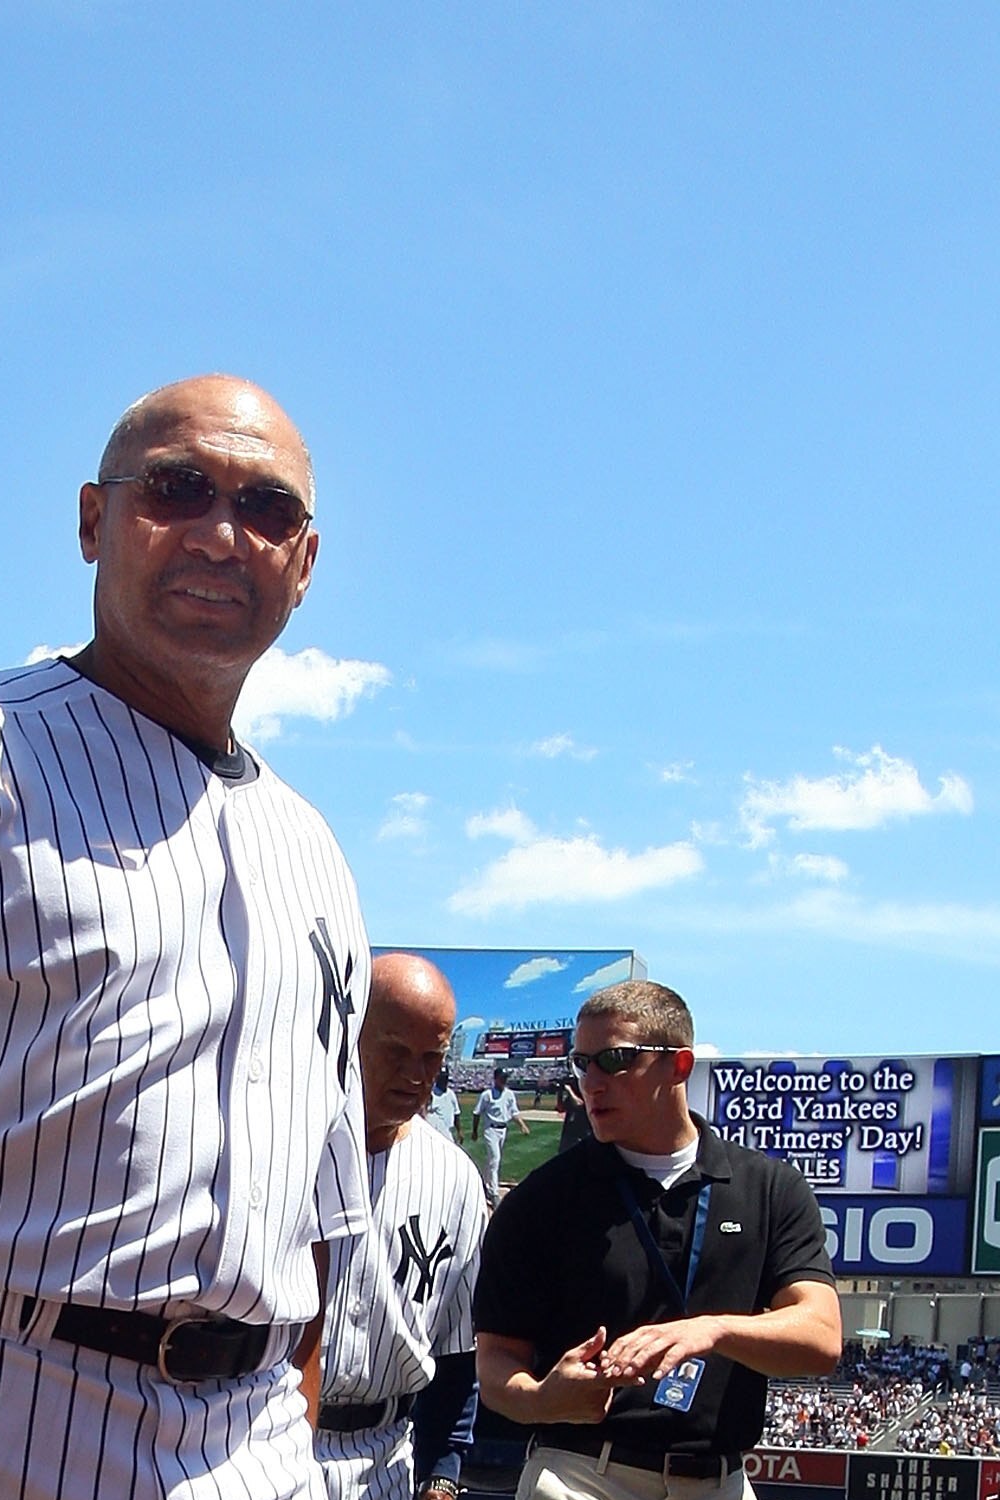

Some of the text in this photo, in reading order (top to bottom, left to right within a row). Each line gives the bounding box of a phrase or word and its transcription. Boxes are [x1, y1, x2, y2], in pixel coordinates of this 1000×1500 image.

[714, 1067, 914, 1091] Welcome to the
[726, 1097, 897, 1120] 63rd Yankees
[861, 1126, 922, 1154] Day!
[782, 1159, 840, 1176] ALES
[896, 1459, 930, 1474] THE
[867, 1472, 958, 1492] SHARPER
